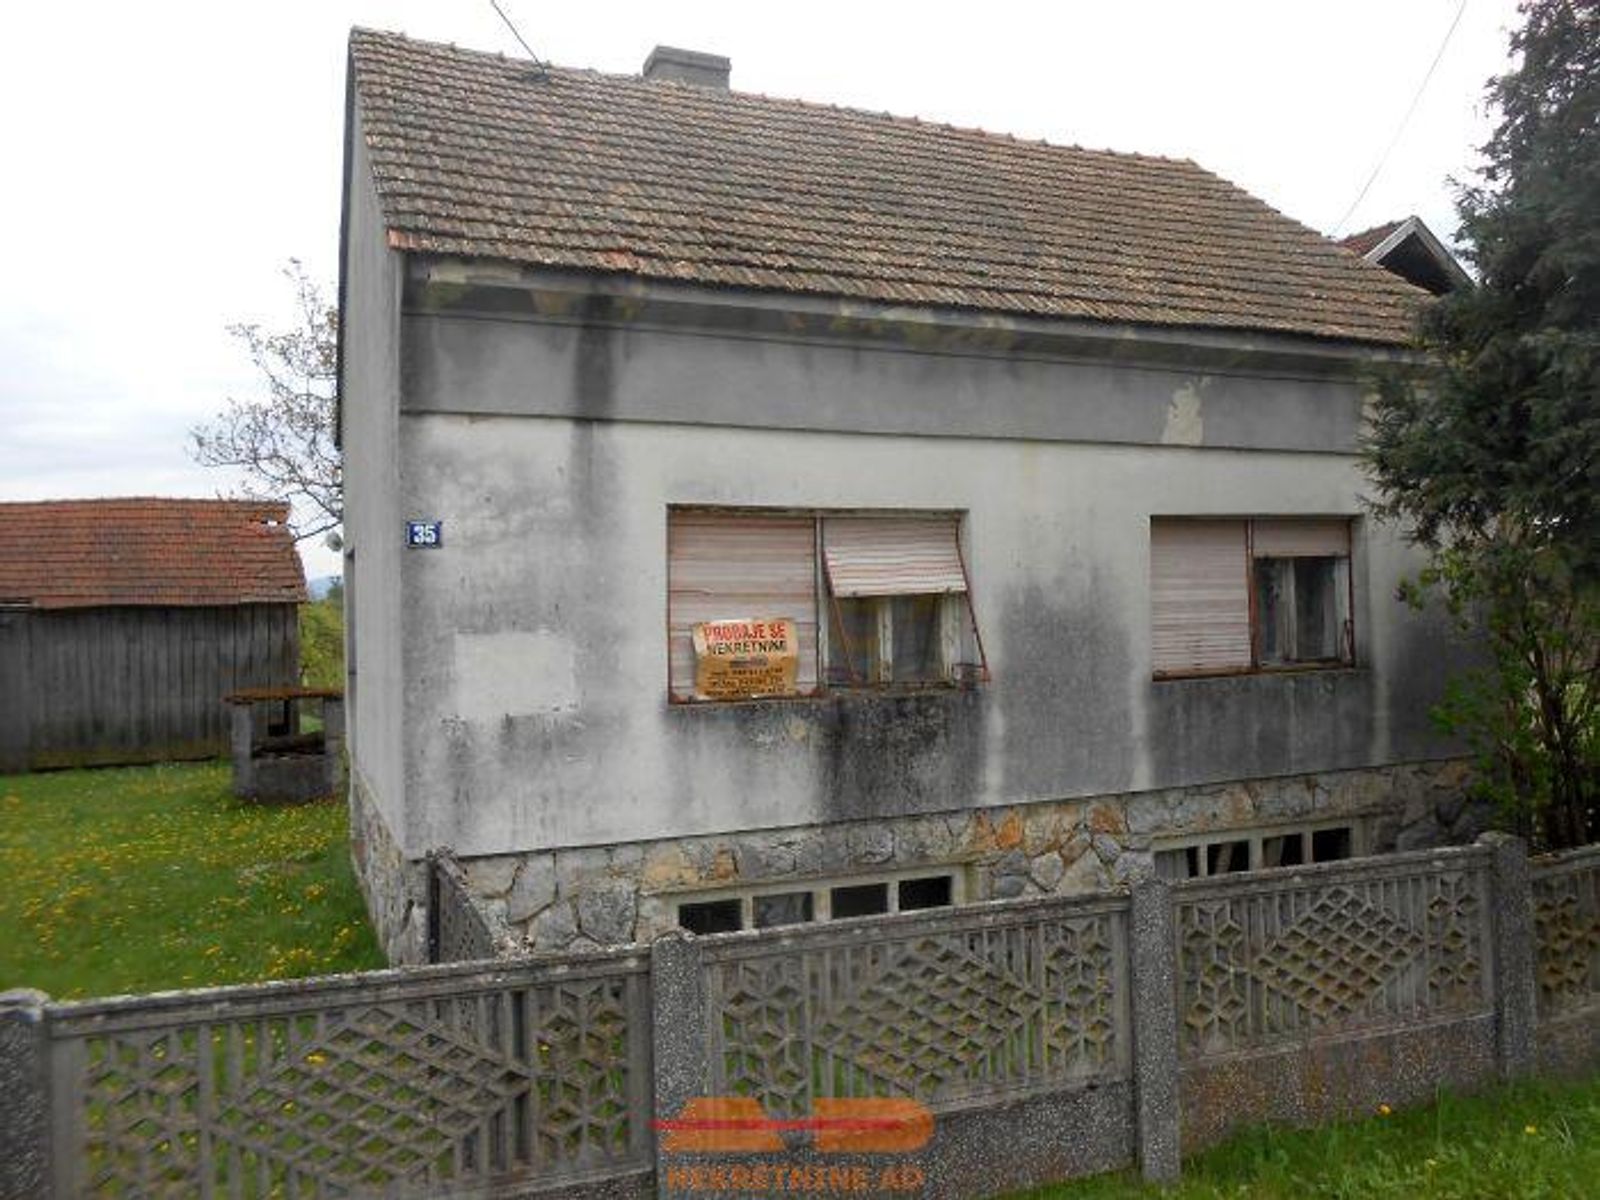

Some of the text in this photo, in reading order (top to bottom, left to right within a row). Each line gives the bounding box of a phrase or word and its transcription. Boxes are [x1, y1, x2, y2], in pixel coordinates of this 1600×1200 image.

[414, 525, 436, 543] 35
[703, 622, 787, 641] PRODAJE SE
